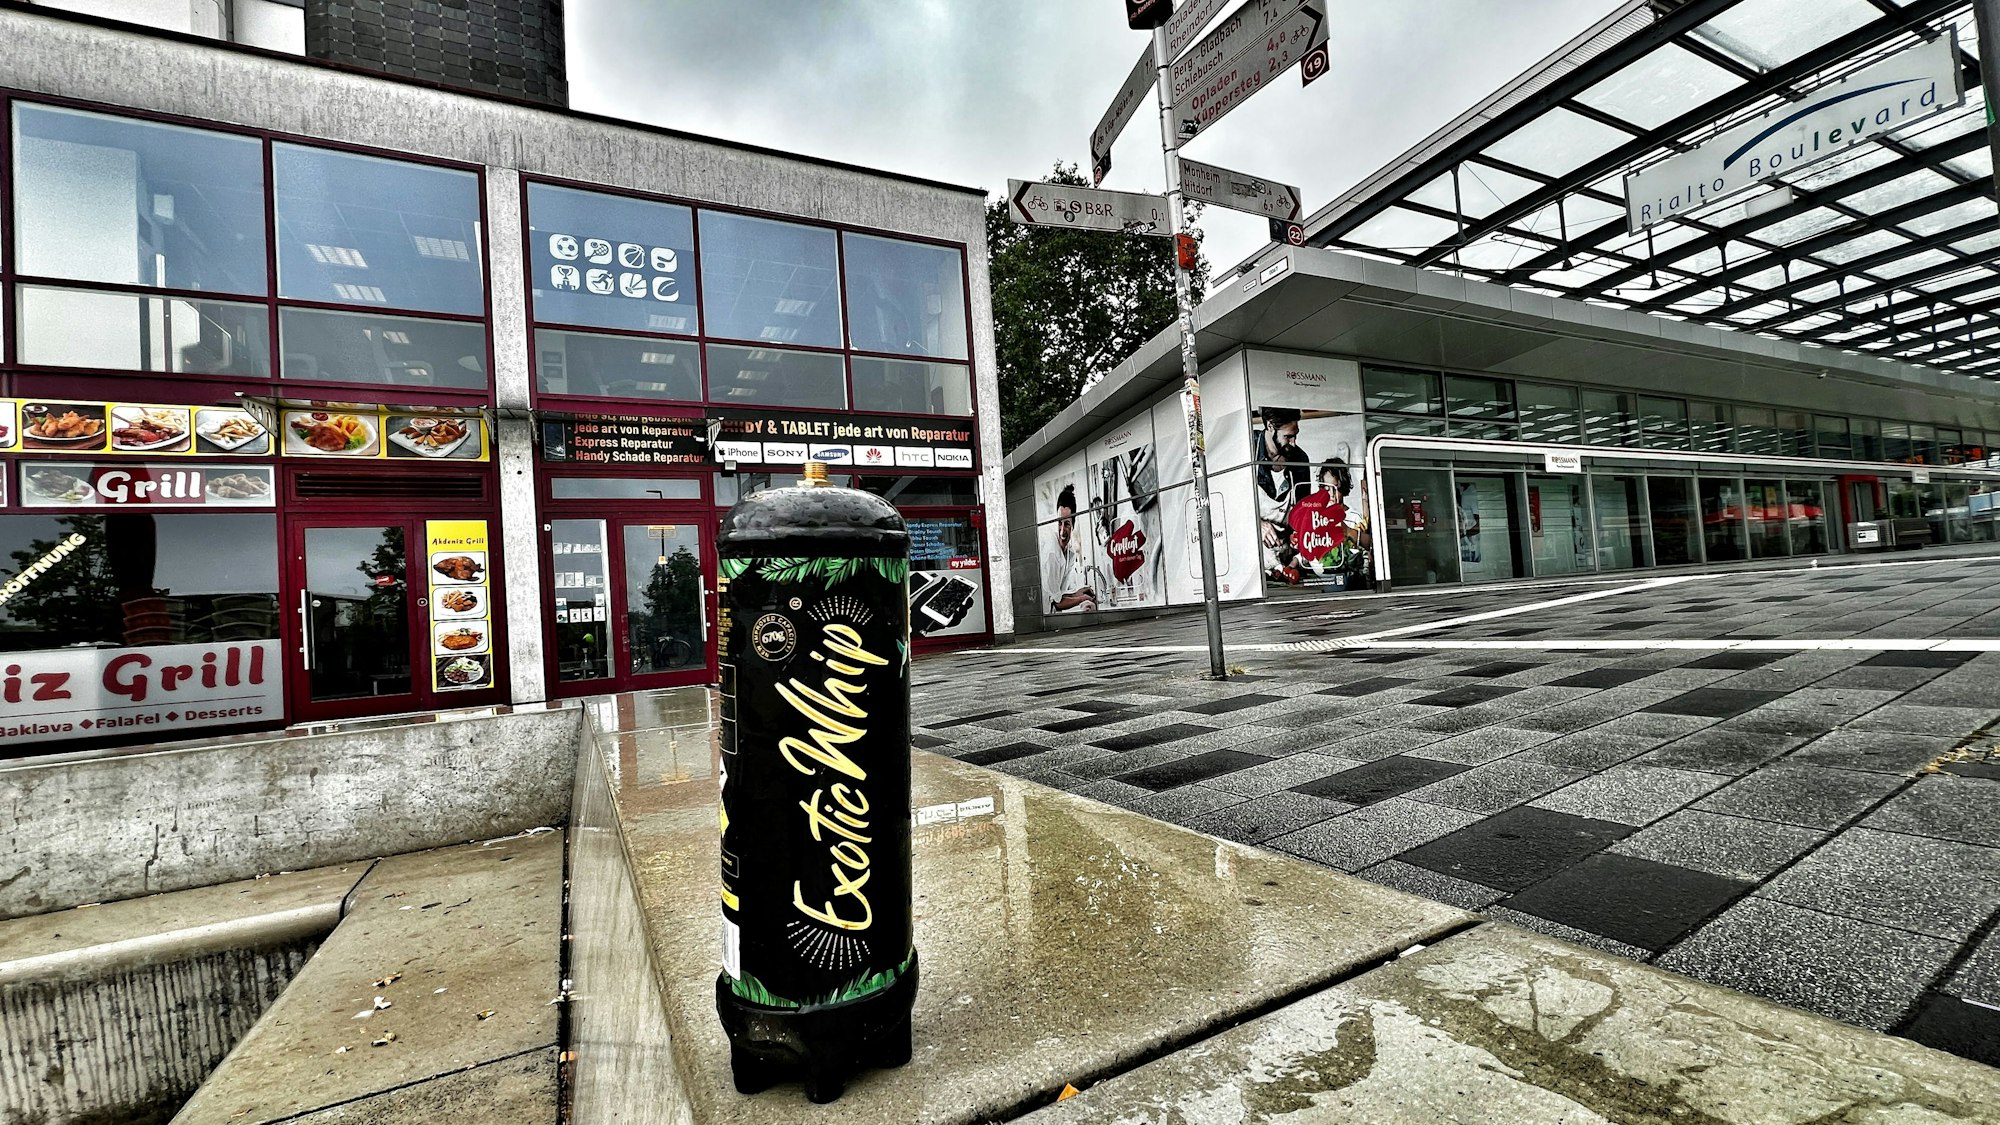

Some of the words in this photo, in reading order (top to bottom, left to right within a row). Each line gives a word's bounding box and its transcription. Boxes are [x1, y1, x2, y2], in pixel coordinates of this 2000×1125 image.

[1174, 16, 1242, 81] Berg.-Gladbach
[1175, 50, 1224, 97] Schlebusch
[1192, 69, 1238, 110] Opladen
[1267, 31, 1286, 51] 4,8
[1306, 56, 1322, 74] 19
[1193, 70, 1261, 126] Küppersteg
[1268, 51, 1288, 74] 2,3
[1641, 178, 1724, 222] Rialto
[1749, 82, 1936, 178] Boulevard
[1183, 163, 1221, 183] Monheim
[1184, 179, 1213, 197] Hitdorf
[1263, 199, 1274, 212] 6,9
[1085, 202, 1114, 217] B&R
[1151, 208, 1165, 222] 0,1
[1291, 230, 1301, 240] 22
[1286, 370, 1327, 381] ROSSMANN
[601, 424, 618, 434] art
[620, 426, 640, 435] von
[642, 425, 694, 437] Reparatur
[767, 420, 778, 434] &
[781, 420, 830, 436] TABLET
[833, 422, 861, 439] jede
[864, 425, 884, 438] art
[885, 427, 908, 439] von
[911, 426, 970, 443] Reparatur
[575, 436, 618, 449] Express
[621, 437, 673, 450] Reparatur
[728, 447, 758, 457] iPhone
[767, 449, 804, 457] SONY
[575, 450, 610, 463] Handy
[612, 451, 651, 462] Schade
[653, 451, 704, 464] Reparatur
[97, 470, 201, 503] Grill
[1311, 510, 1334, 530] Bio-
[432, 537, 463, 546] Akdeniz
[1110, 535, 1138, 557] Gepflegt
[1303, 531, 1334, 553] Glück
[754, 615, 776, 644] IMPROVED
[761, 630, 786, 644] 670g
[757, 645, 770, 658] NEW
[102, 646, 265, 702] Grill
[774, 623, 890, 781] Whip
[96, 712, 160, 729] Falafel
[185, 704, 263, 721] Desserts
[792, 782, 873, 931] Exotic
